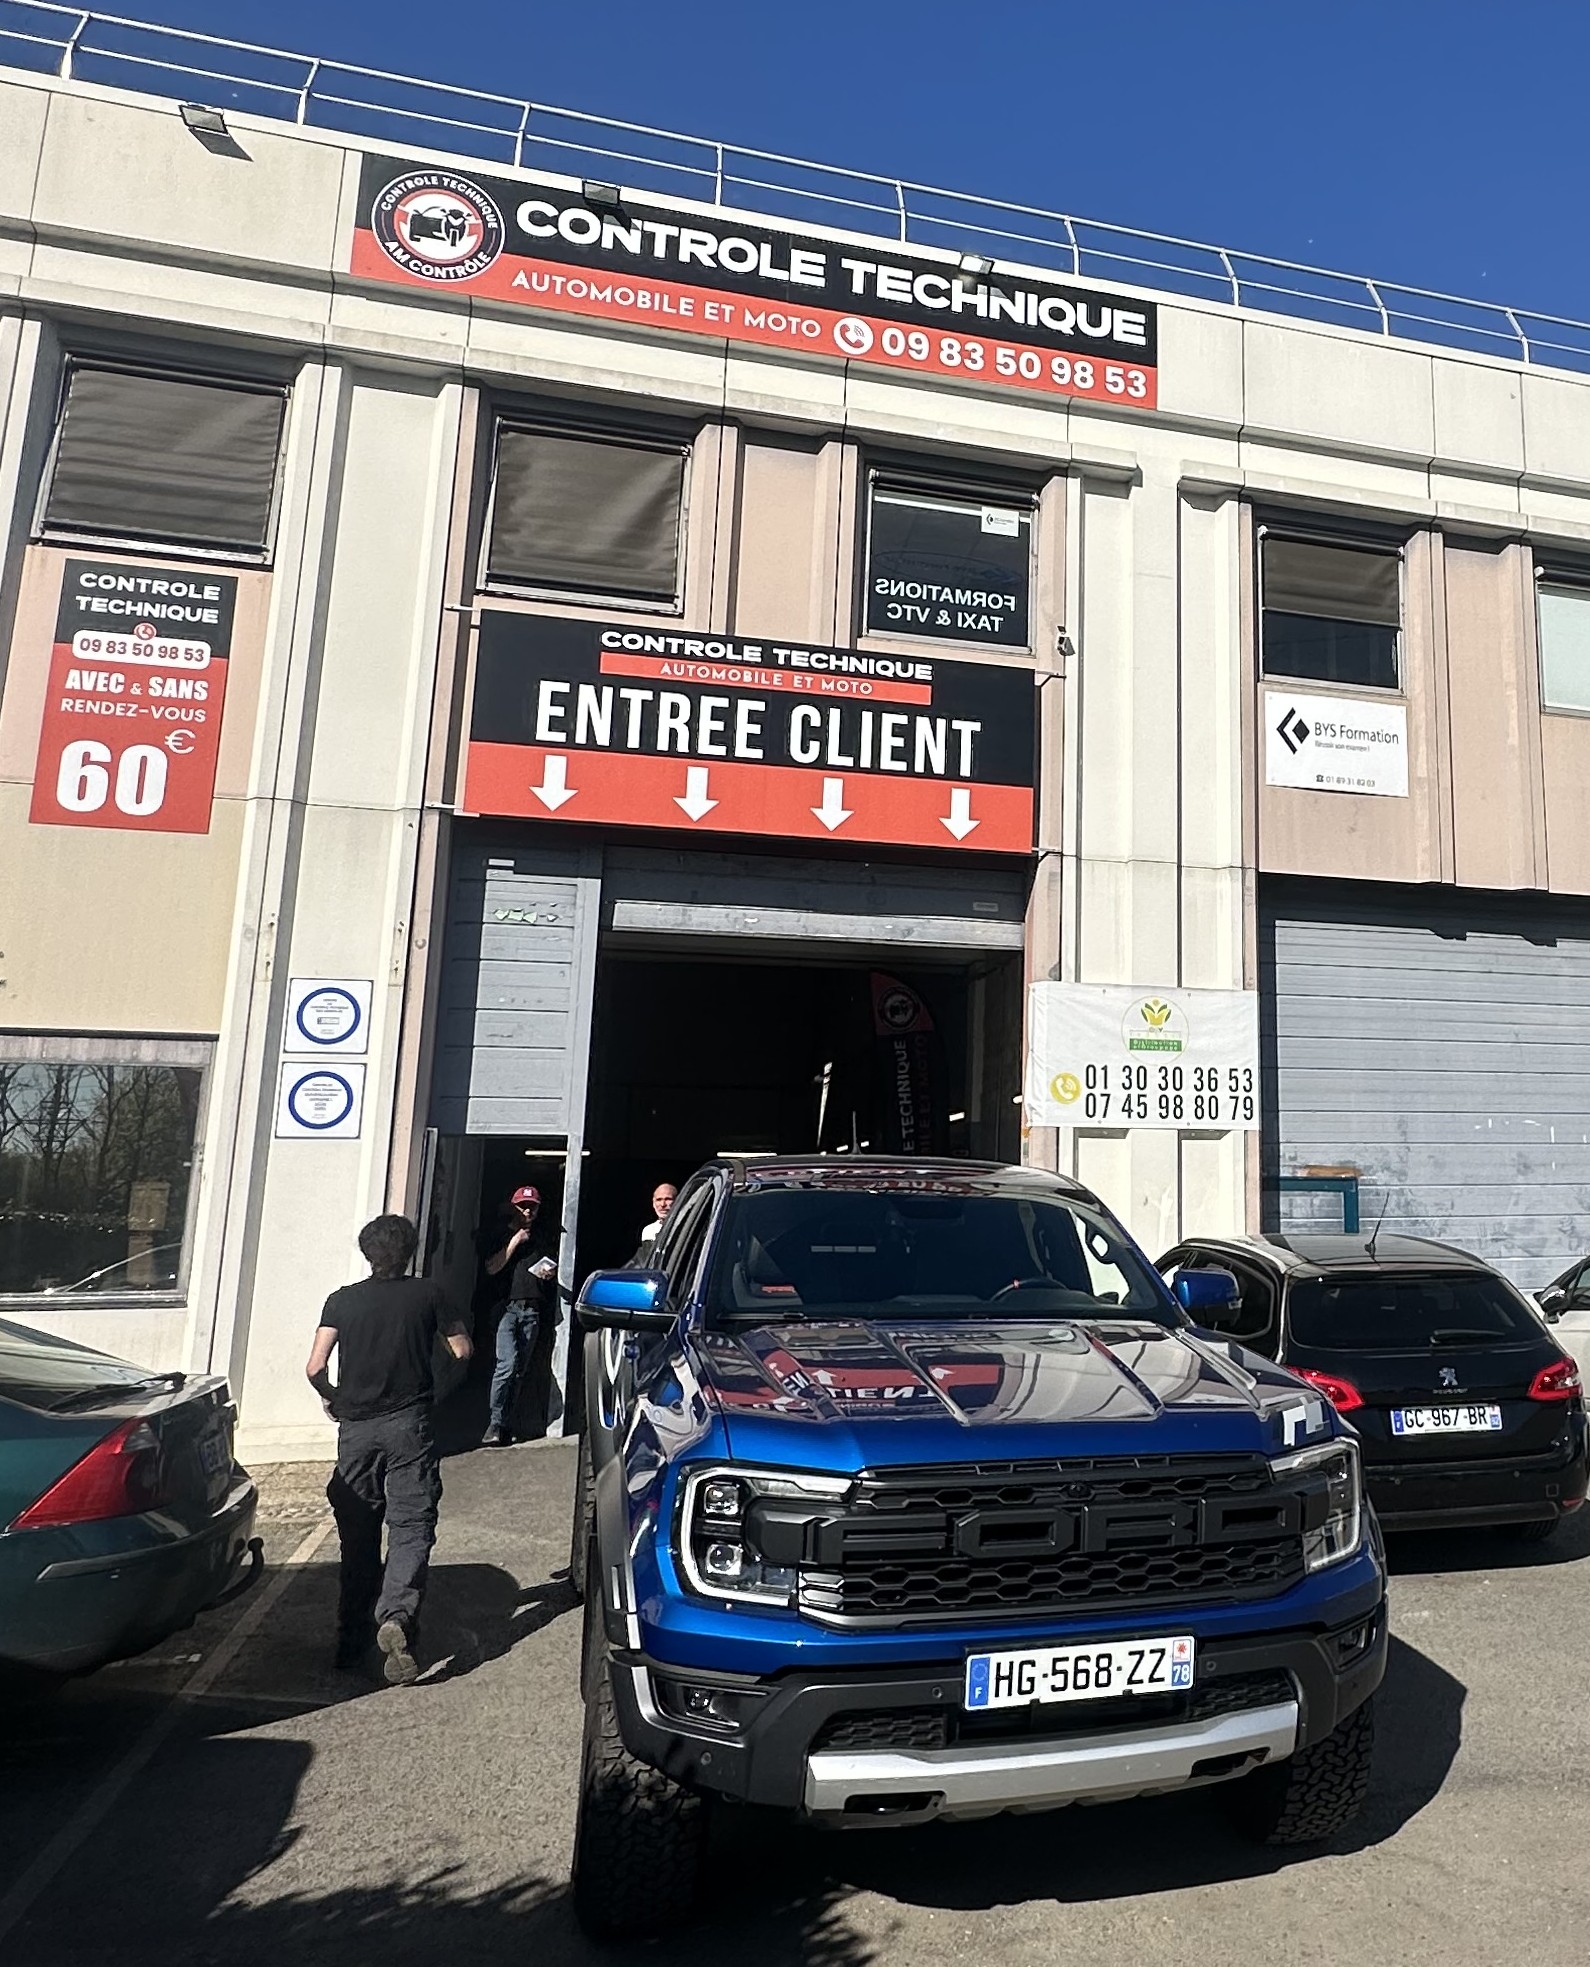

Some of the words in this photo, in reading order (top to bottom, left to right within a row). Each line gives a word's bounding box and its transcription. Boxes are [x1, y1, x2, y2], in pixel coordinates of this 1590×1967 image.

[381, 175, 439, 211] CONTROLE
[442, 177, 498, 228] TECHNIQUE
[383, 241, 411, 263] AM
[408, 251, 491, 279] CONTRÔLE
[516, 200, 826, 288] CONTROLE
[841, 257, 1147, 346] TECHNIQUE
[511, 270, 695, 317] AUTOMOBILE
[704, 300, 735, 324] ET
[743, 308, 821, 338] MOTO
[881, 327, 930, 361] 09
[939, 337, 985, 371] 83
[995, 350, 1041, 380] 50
[1051, 360, 1095, 390] 98
[1104, 366, 1147, 398] 53
[79, 572, 221, 601] CONTROLE
[75, 595, 219, 624] TECHNIQUE
[80, 637, 101, 652] 09
[106, 641, 128, 655] 83
[132, 643, 153, 658] 50
[158, 645, 179, 660] 98
[184, 647, 205, 662] 53
[601, 630, 762, 664] CONTROLE
[772, 647, 933, 681] TECHNIQUE
[65, 669, 125, 694] AVEC
[130, 682, 143, 695] &
[148, 676, 208, 701] SANS
[660, 662, 784, 687] AUTOMOBILE
[793, 675, 815, 690] ET
[821, 680, 874, 696] MOTO
[60, 698, 206, 722] RENDEZ-VOUS
[535, 679, 766, 760] ENTREE
[789, 704, 982, 777] CLIENT
[1314, 722, 1337, 738] BYS
[1340, 724, 1399, 744] Formation
[56, 739, 169, 816] 60
[164, 729, 196, 754] €
[893, 1039, 915, 1139] TECHNIQUE
[1085, 1064, 1109, 1090] 01
[1121, 1065, 1148, 1091] 30
[1158, 1066, 1183, 1092] 30
[1193, 1067, 1218, 1093] 36
[1228, 1068, 1253, 1093] 53
[1085, 1093, 1111, 1118] 07
[1121, 1093, 1148, 1119] 45
[1158, 1094, 1184, 1120] 98
[1194, 1095, 1219, 1120] 80
[1229, 1095, 1254, 1121] 79
[1404, 1405, 1488, 1429] GC-967-BR
[975, 1686, 982, 1699] F
[994, 1648, 1167, 1698] HG-568-ZZ
[1173, 1664, 1190, 1684] 78
